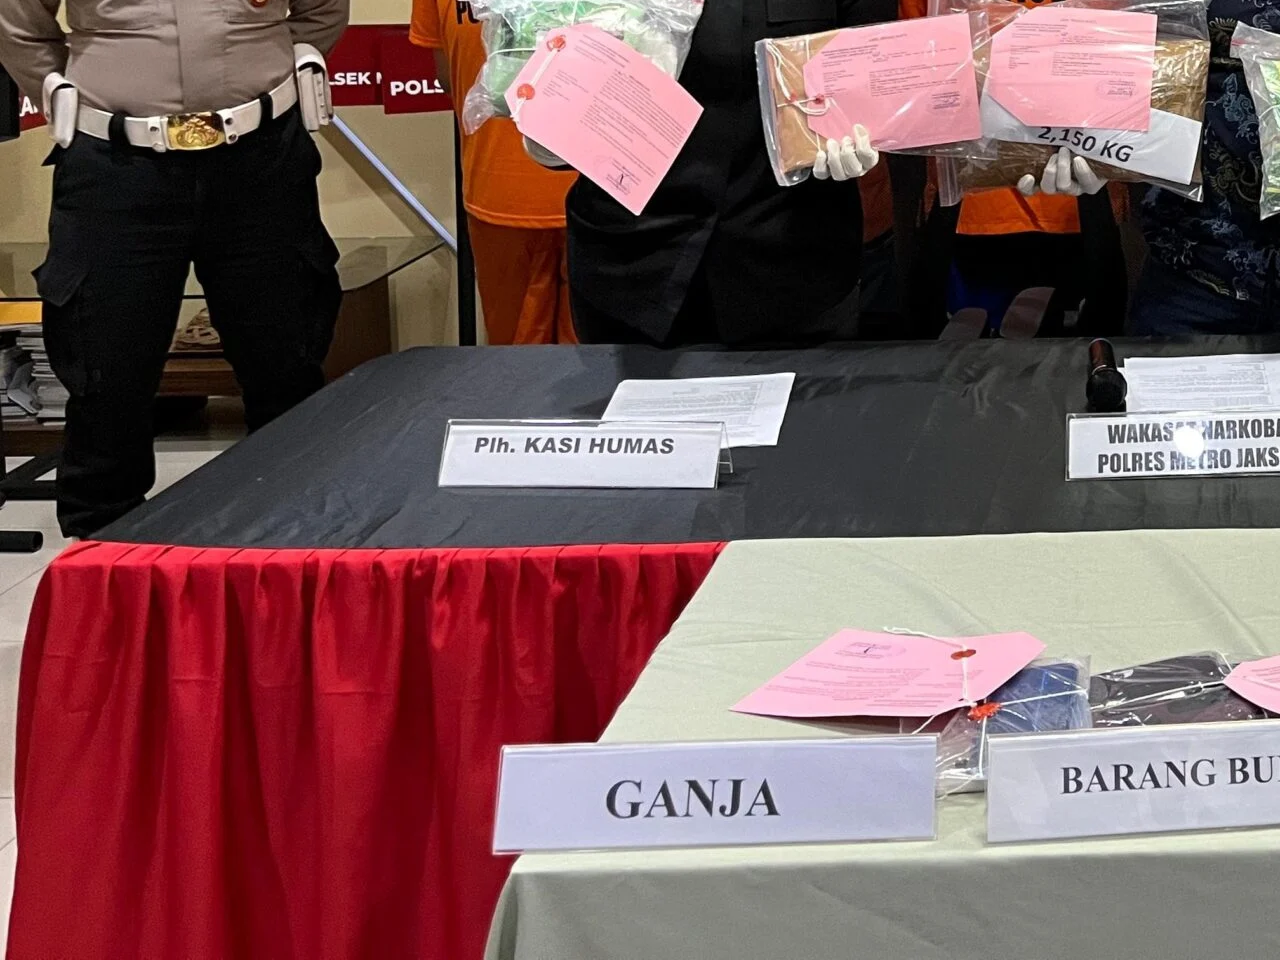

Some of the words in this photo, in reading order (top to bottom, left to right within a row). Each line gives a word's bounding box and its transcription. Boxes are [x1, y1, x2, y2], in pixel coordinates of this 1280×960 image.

[329, 72, 371, 86] SEK
[1037, 126, 1097, 152] 2,150
[1100, 140, 1134, 163] KG
[1107, 420, 1196, 444] WAKAS
[474, 437, 516, 454] Plh.
[524, 437, 580, 454] KASI
[588, 437, 675, 455] HUMAS
[1098, 451, 1165, 474] POLRES
[1060, 758, 1216, 795] BARANG
[605, 778, 781, 820] GANJA
